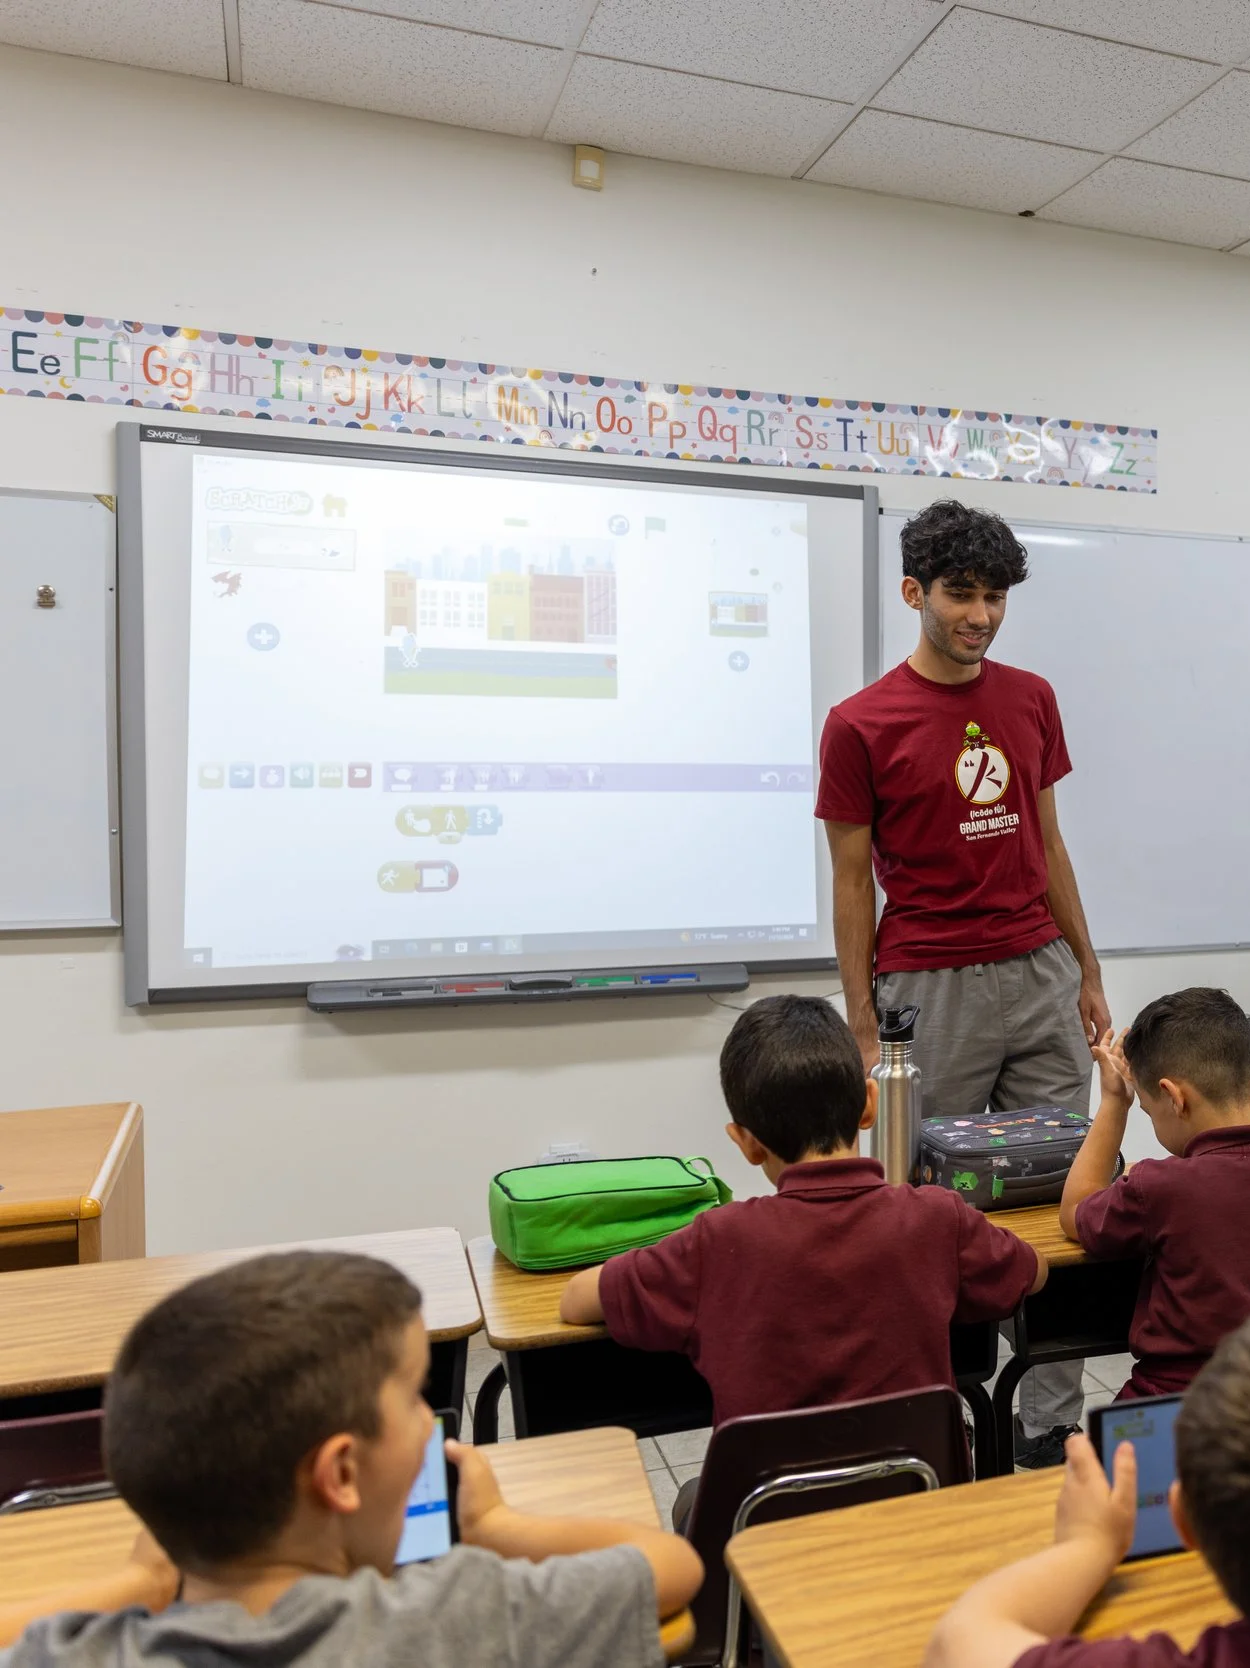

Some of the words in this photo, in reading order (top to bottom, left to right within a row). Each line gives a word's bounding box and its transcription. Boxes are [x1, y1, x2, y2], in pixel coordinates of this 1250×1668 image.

[12, 331, 61, 375] Ee
[75, 337, 119, 381] Ff
[142, 345, 193, 401] Gg
[209, 352, 255, 397] Hh
[333, 368, 371, 420] Jj
[383, 372, 424, 414] Kk
[436, 378, 472, 419] Ll
[497, 385, 538, 425] Mm
[548, 390, 586, 430] Nn
[596, 396, 633, 435] Oo
[648, 402, 687, 449] Pp
[697, 405, 737, 455] Qq
[747, 409, 779, 446] Rr
[795, 415, 829, 450] Ss
[836, 417, 867, 453] Tt
[877, 422, 910, 456] Uu
[1110, 442, 1137, 475] Zz
[147, 429, 177, 440] SMART
[960, 819, 988, 835] GRAND
[988, 813, 1020, 831] MASTER
[977, 830, 1000, 840] Fernando
[1000, 828, 1016, 836] Valley
